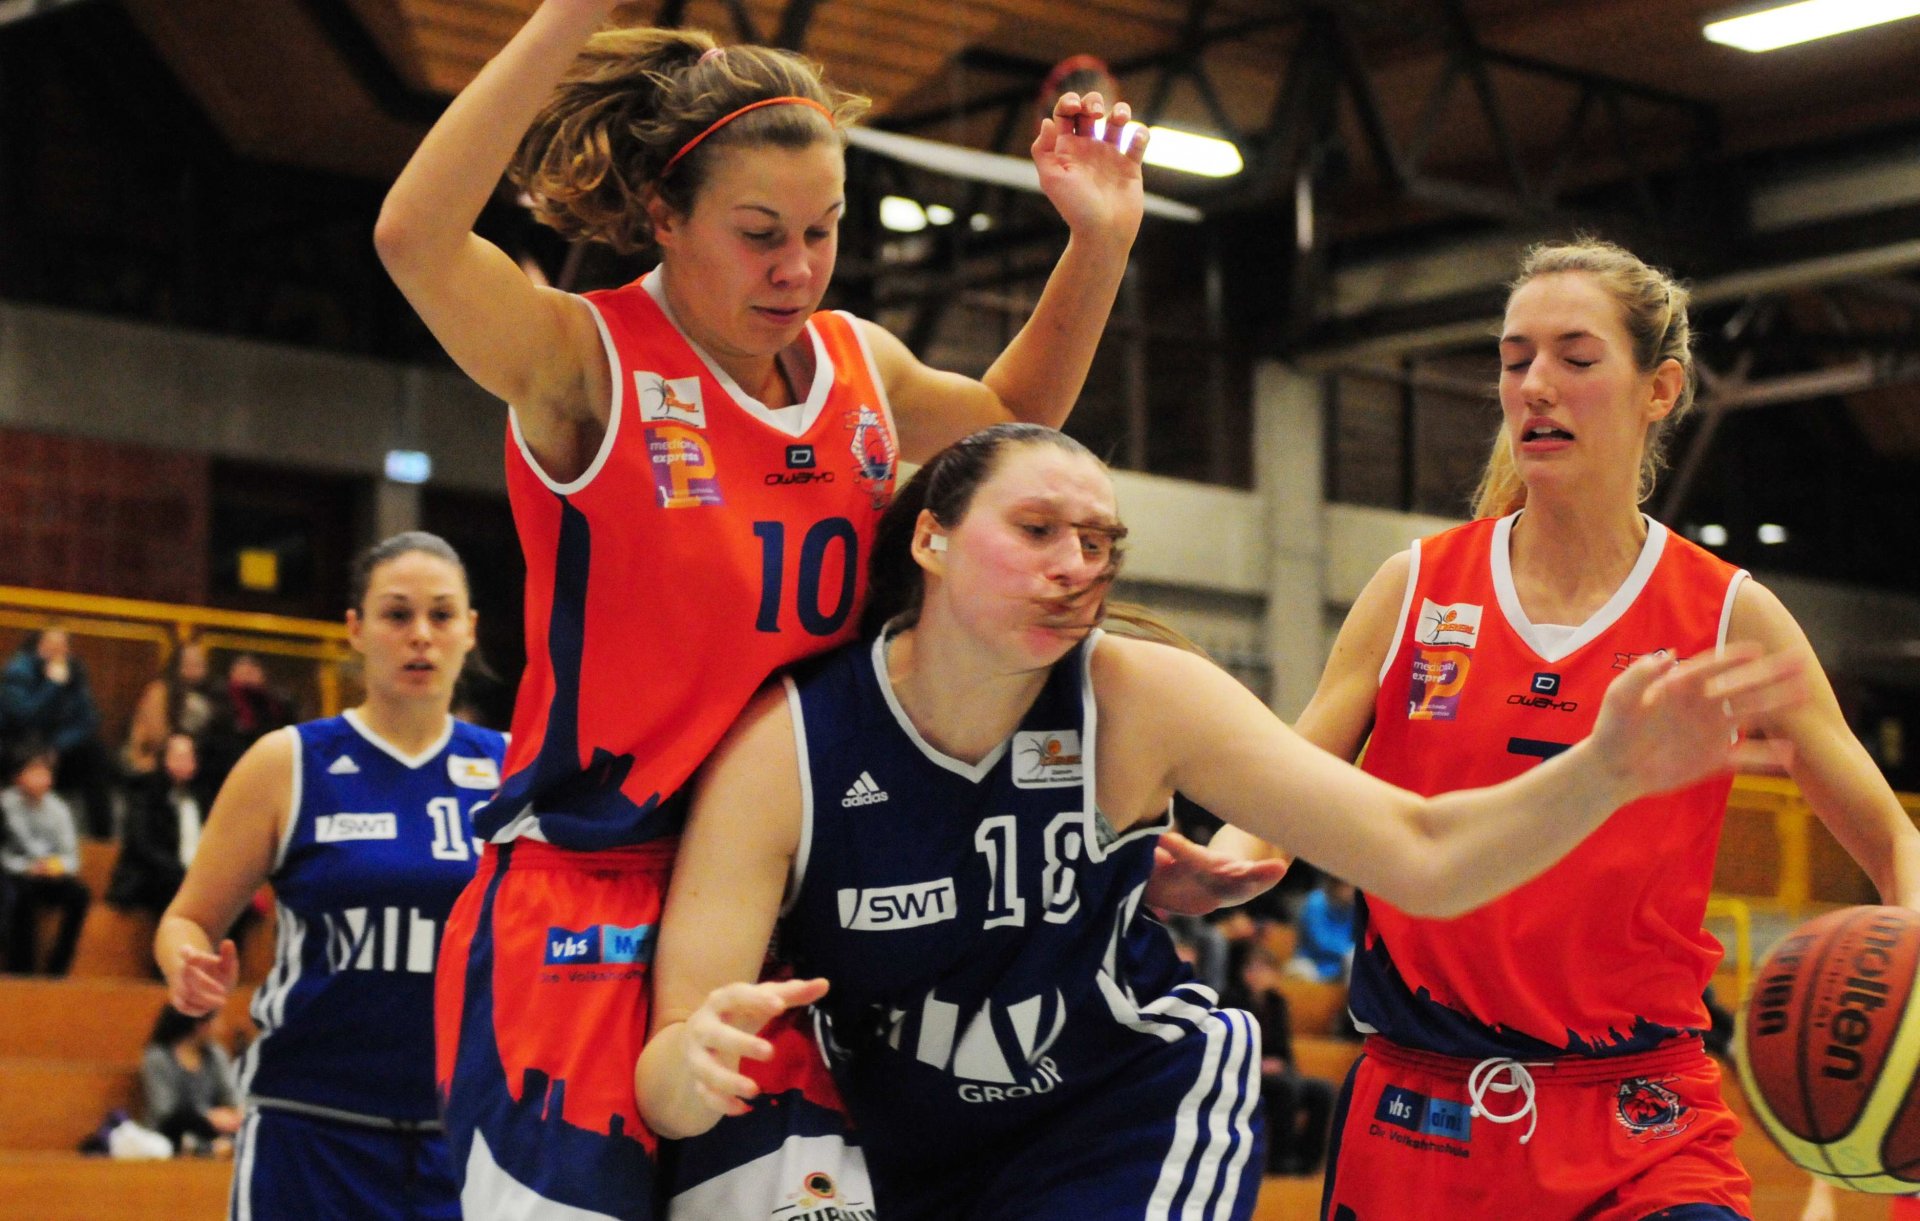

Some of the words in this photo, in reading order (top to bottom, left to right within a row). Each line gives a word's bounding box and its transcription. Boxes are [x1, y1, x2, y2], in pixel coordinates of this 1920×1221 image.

[752, 516, 858, 636] 10
[842, 791, 888, 808] adidas
[338, 818, 389, 836] SWT
[974, 811, 1084, 930] 18
[870, 886, 950, 923] SWT
[551, 936, 589, 958] vhs
[1822, 914, 1907, 1081] molten
[958, 1055, 1063, 1103] GROUP
[1388, 1093, 1413, 1119] vhs
